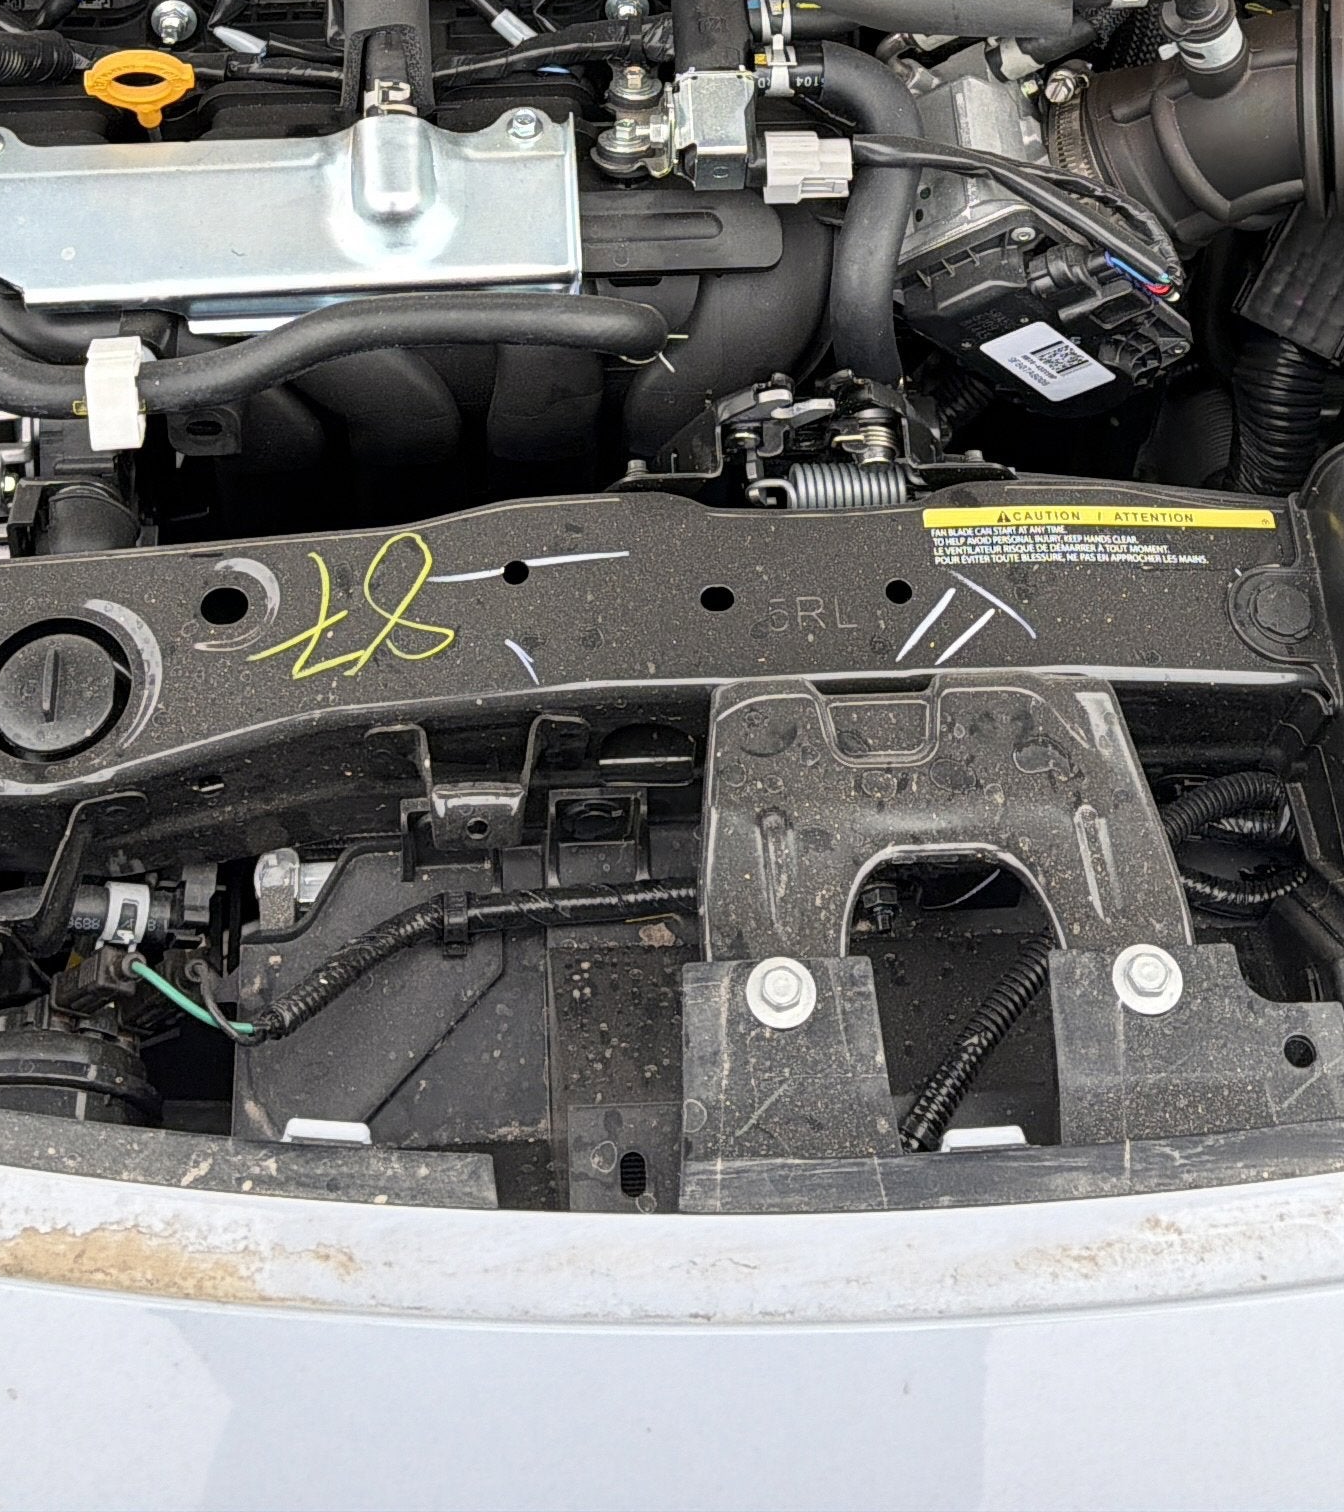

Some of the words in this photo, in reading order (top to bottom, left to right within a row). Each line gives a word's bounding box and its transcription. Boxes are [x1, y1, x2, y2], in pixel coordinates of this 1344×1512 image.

[1013, 510, 1081, 522] CAUTION
[1114, 511, 1194, 523] ATTENTION
[930, 528, 947, 537] FAN
[948, 528, 974, 537] BLADE
[975, 528, 993, 536] CAN
[993, 527, 1017, 536] START
[1018, 527, 1029, 535] AT
[1029, 526, 1045, 535] ANY
[1046, 525, 1068, 535] TIME.
[933, 538, 944, 546] TO
[945, 537, 966, 546] HELP
[966, 537, 992, 546] AVOID
[993, 536, 1034, 544] PERSONAL
[1064, 535, 1083, 543] KEEP
[1084, 535, 1111, 544] HANDS
[1112, 535, 1140, 544] CLEAR.
[933, 546, 945, 556] LE
[945, 545, 1002, 555] VENTILATEUR
[1002, 544, 1035, 553] RISQUE
[1036, 544, 1048, 552] DE
[1049, 542, 1097, 552] DÉMARRER
[1097, 542, 1105, 552] À
[1106, 544, 1128, 553] TOUT
[1129, 544, 1171, 554] MOMENT.
[934, 555, 961, 565] POUR
[961, 553, 991, 564] ÉVITER
[992, 554, 1021, 563] TOUTE
[1066, 553, 1079, 562] NE
[1080, 553, 1096, 562] PAS
[1097, 553, 1110, 562] EN
[1111, 553, 1163, 563] APPROCHER
[1163, 554, 1178, 564] LES
[1178, 555, 1210, 565] MAINS.
